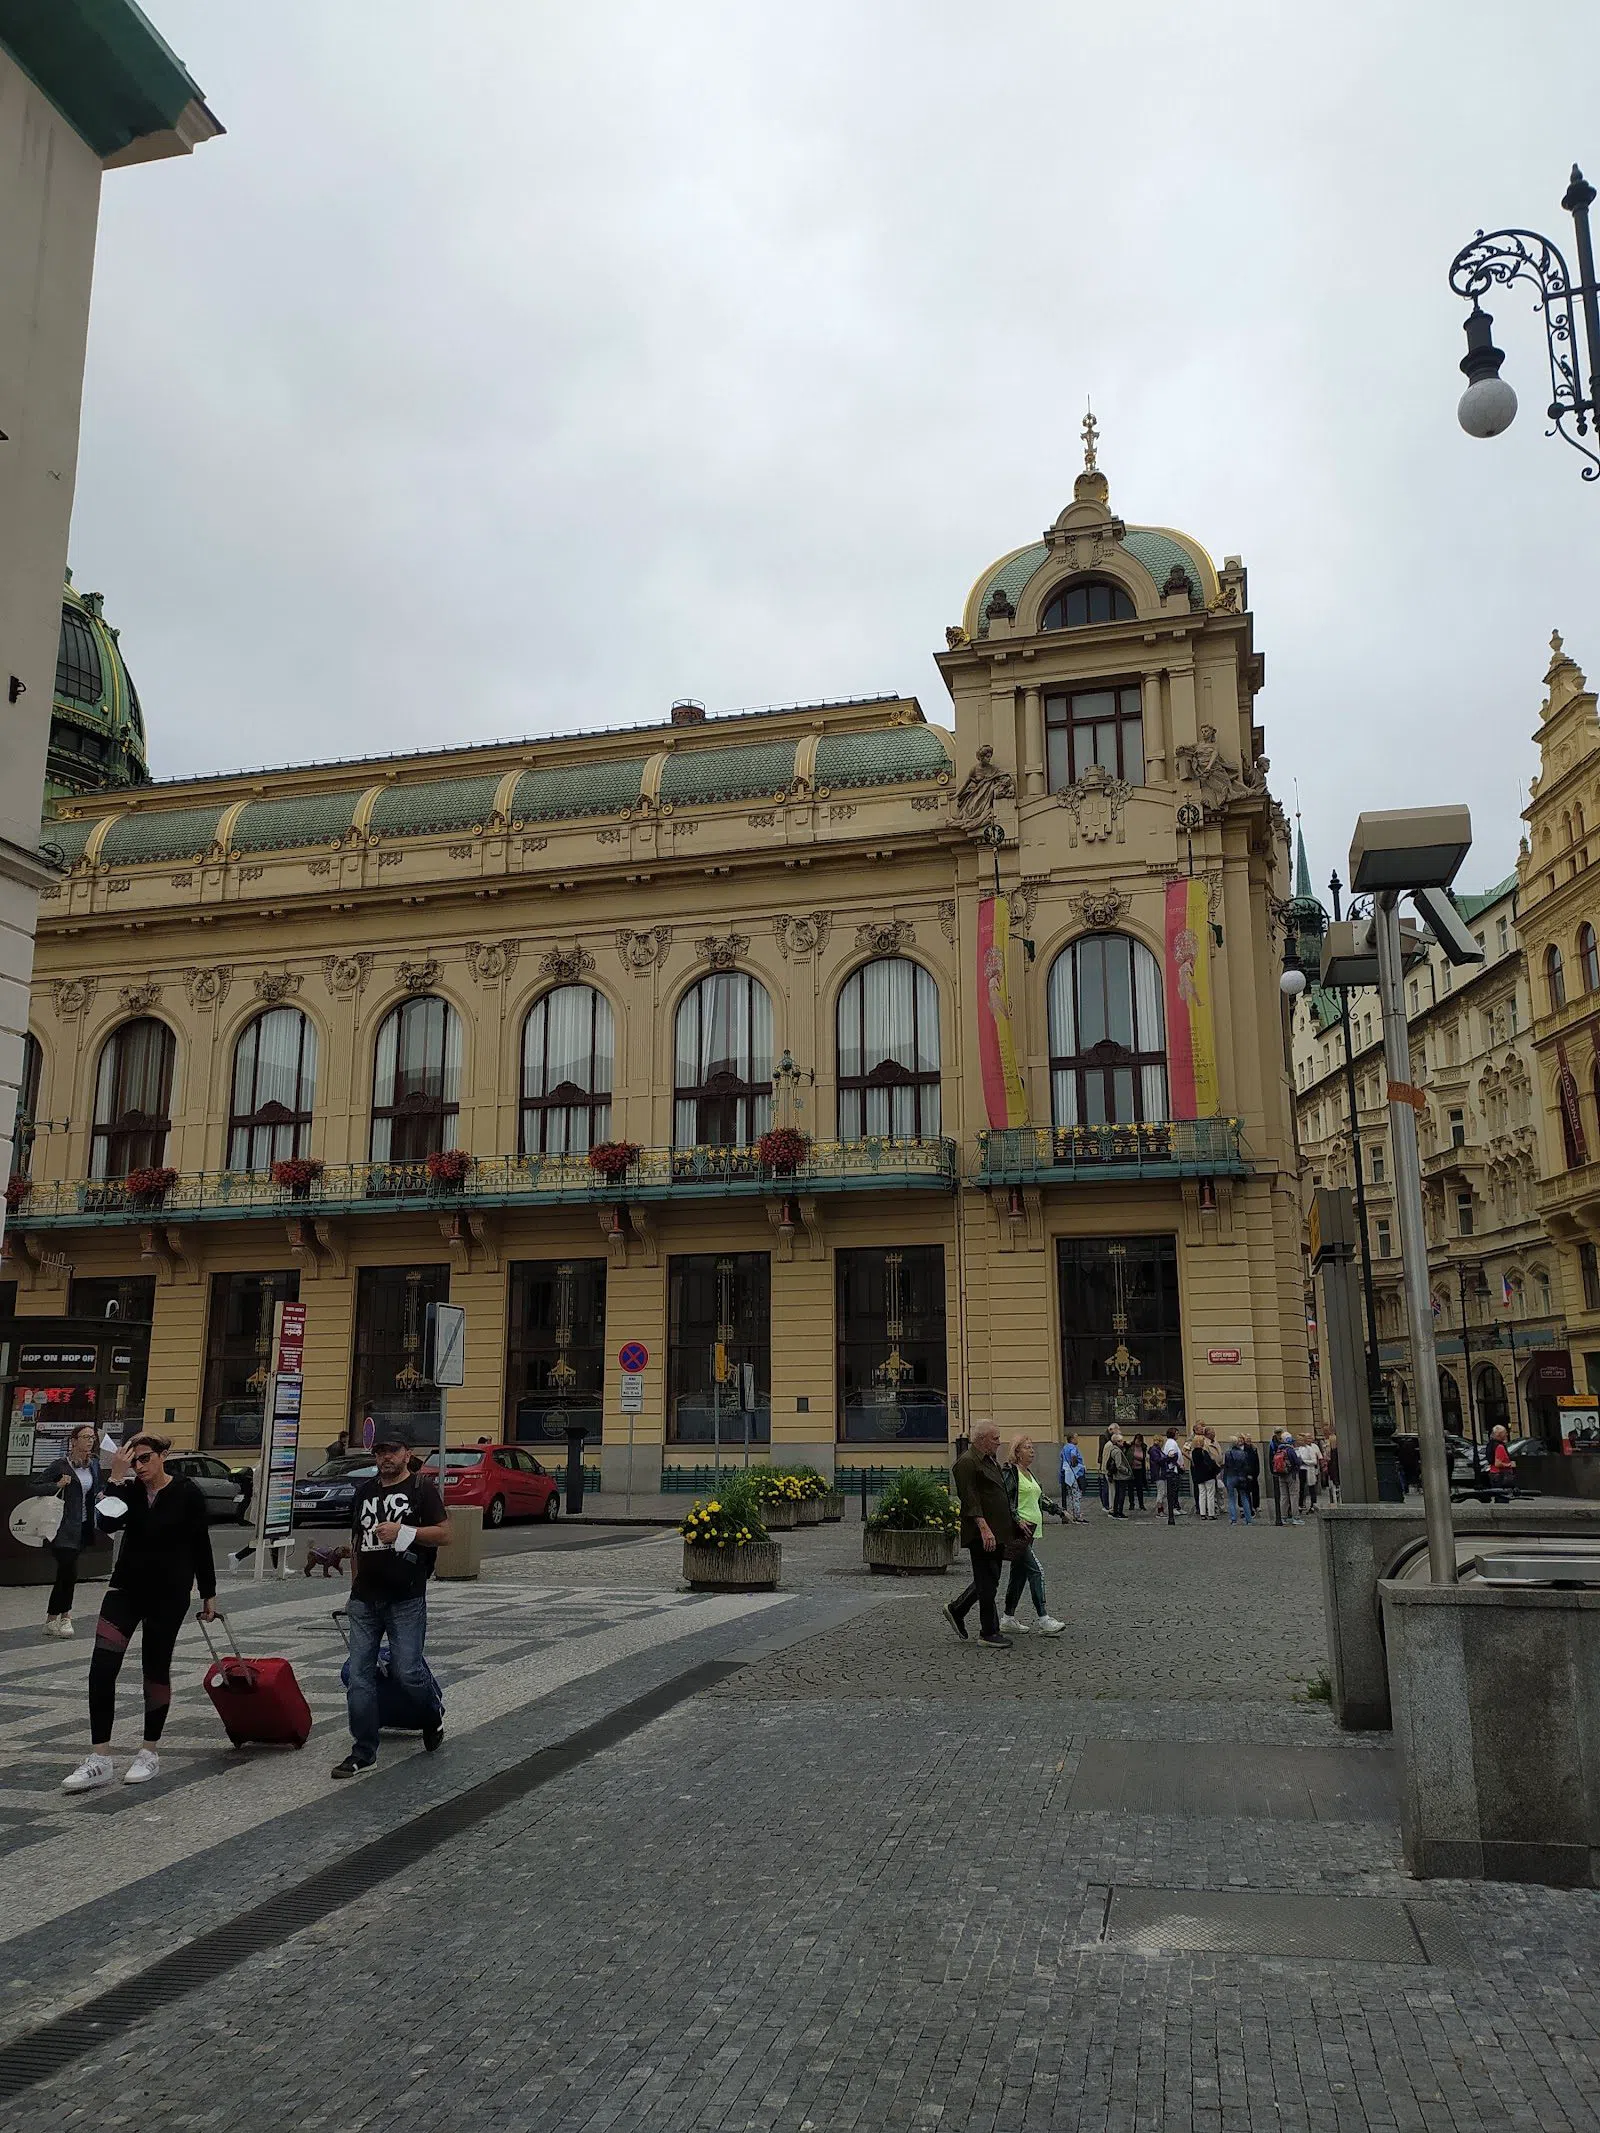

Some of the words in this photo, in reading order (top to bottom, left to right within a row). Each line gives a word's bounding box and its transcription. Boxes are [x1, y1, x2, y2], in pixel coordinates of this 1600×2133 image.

[22, 1354, 41, 1362] HOP
[43, 1354, 58, 1362] ON
[61, 1354, 80, 1362] HOP
[82, 1354, 95, 1363] OFF
[12, 1433, 30, 1447] 11:00
